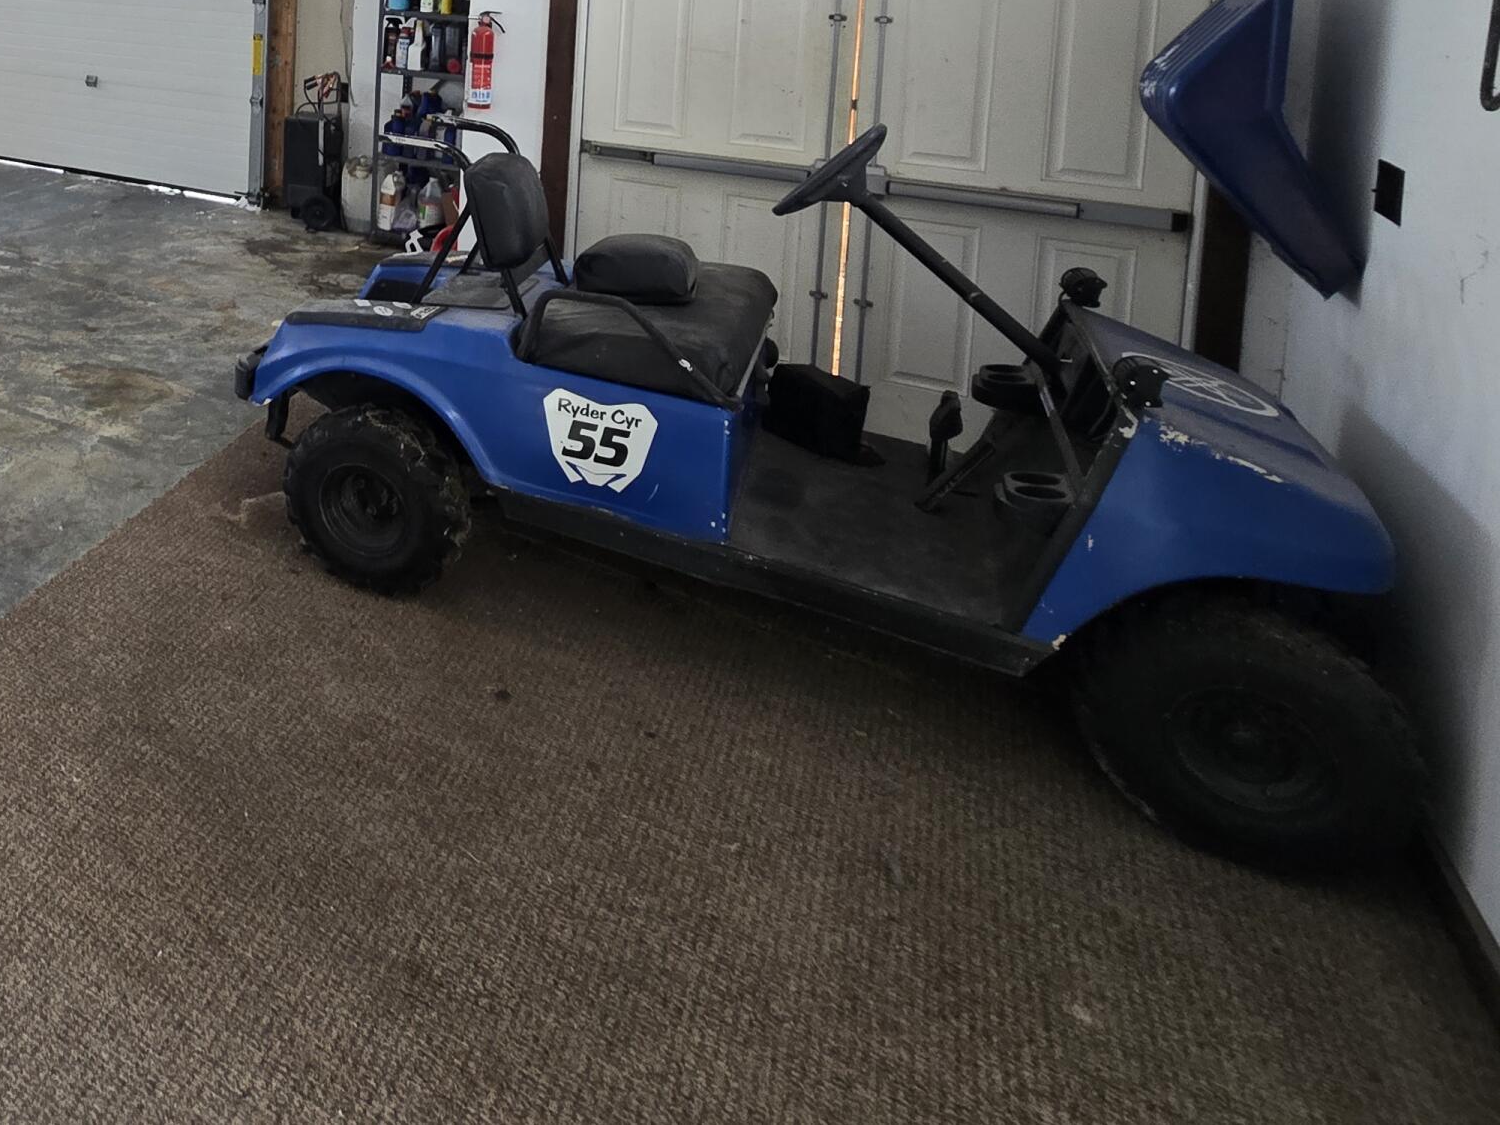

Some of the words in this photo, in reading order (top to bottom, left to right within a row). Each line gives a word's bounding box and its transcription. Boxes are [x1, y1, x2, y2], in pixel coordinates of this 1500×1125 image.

[557, 397, 607, 420] Ryder
[611, 408, 643, 429] Cyr
[561, 419, 631, 467] 55
